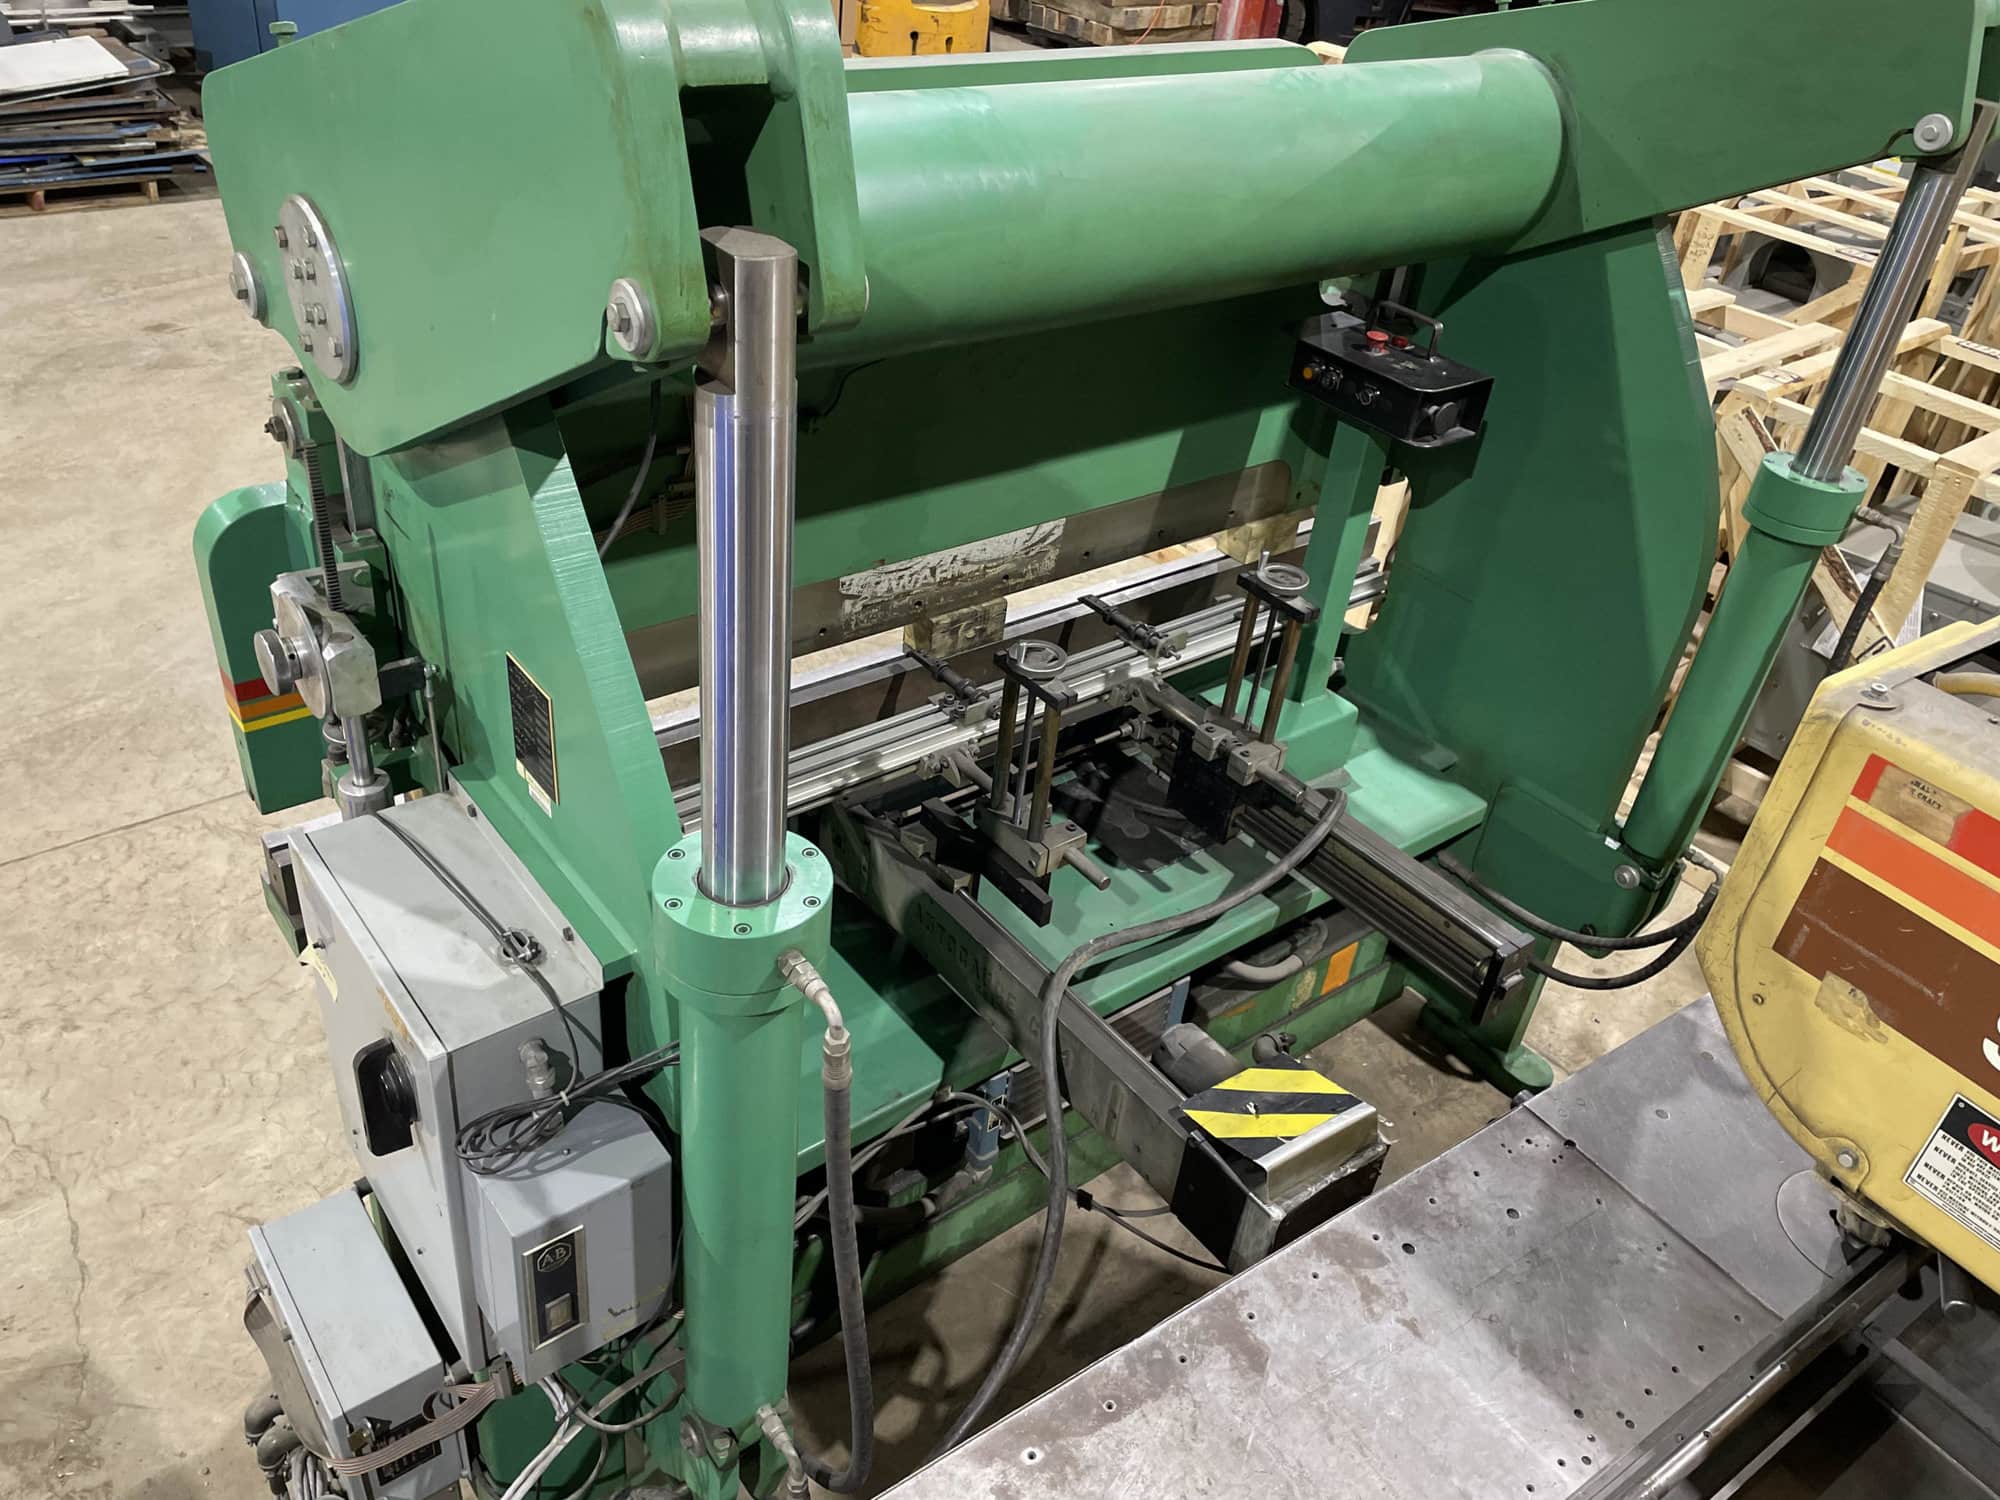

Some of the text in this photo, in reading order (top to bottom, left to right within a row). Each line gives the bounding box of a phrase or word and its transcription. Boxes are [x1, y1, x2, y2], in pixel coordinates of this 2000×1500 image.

[1941, 1134, 1965, 1152] NEVER
[1934, 1146, 1957, 1163] NEVER
[1924, 1162, 1946, 1180] NEVER
[1916, 1173, 1939, 1192] NEVER
